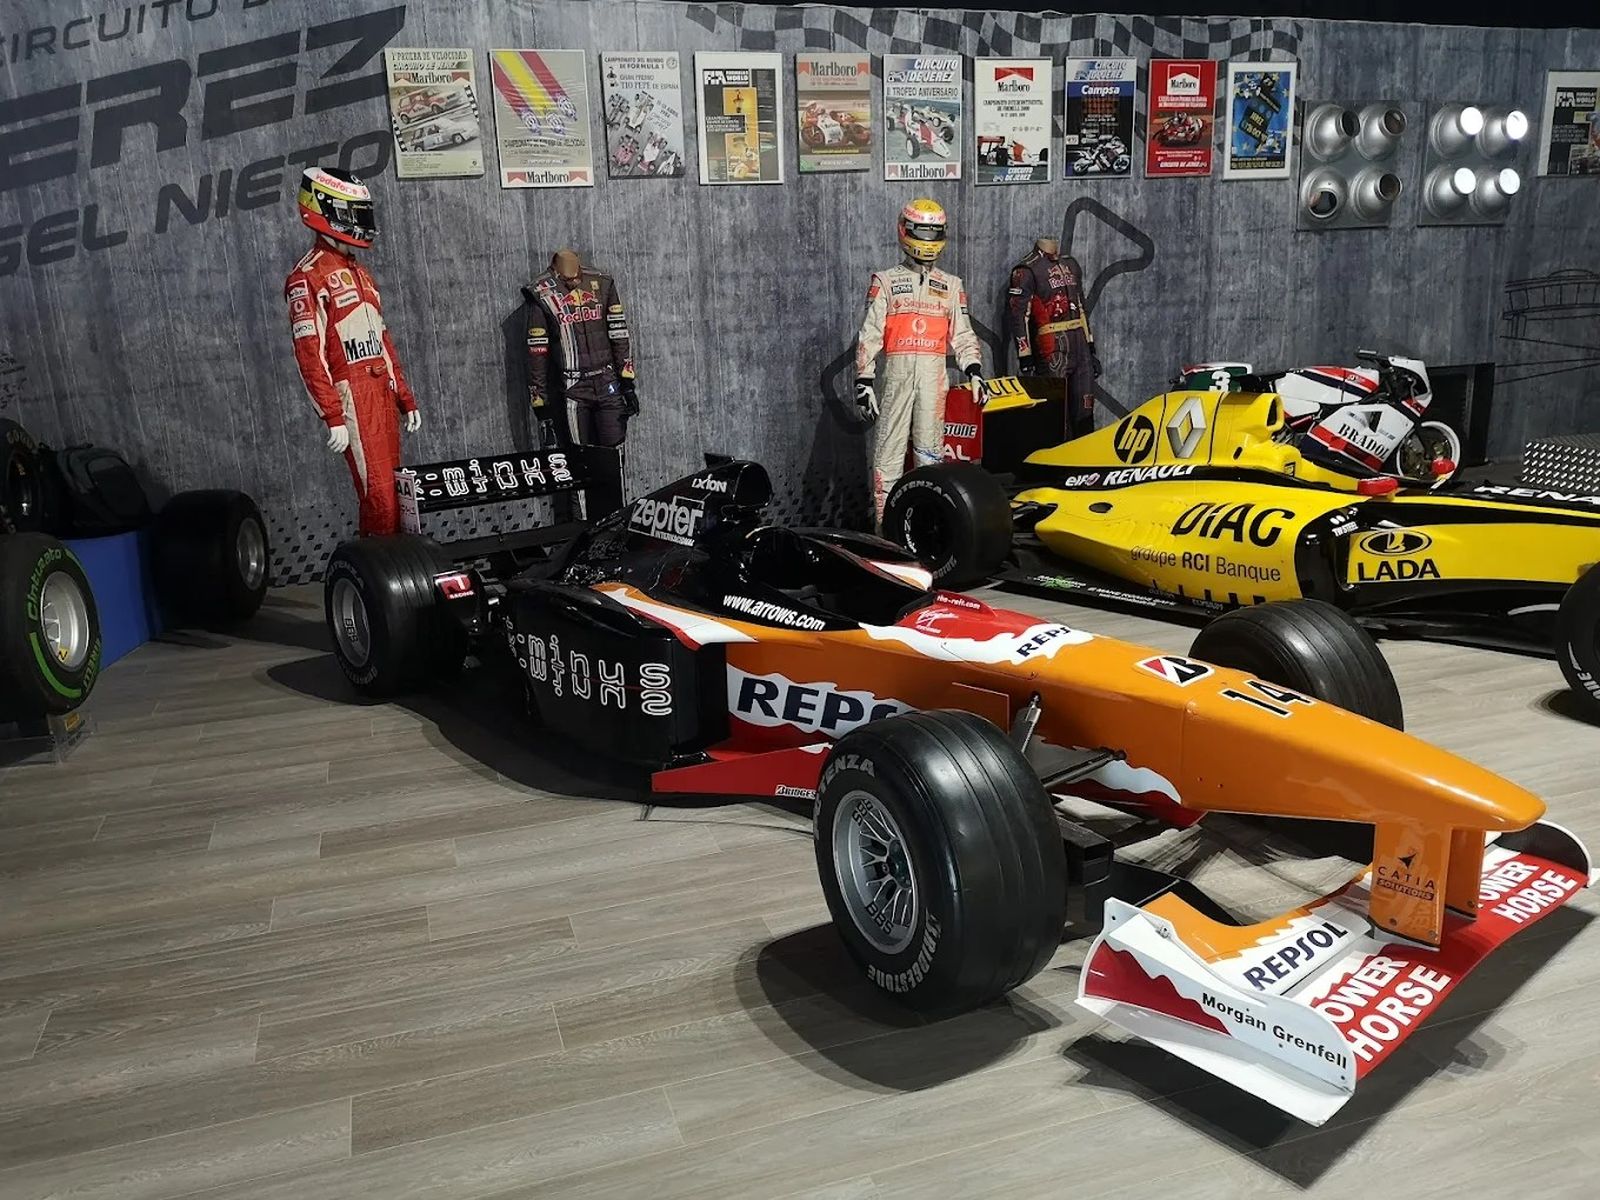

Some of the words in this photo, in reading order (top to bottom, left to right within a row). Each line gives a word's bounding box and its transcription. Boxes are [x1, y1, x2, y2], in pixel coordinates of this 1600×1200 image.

[0, 0, 218, 65] IRCUITO
[432, 51, 468, 60] VELOCIDAD
[914, 59, 959, 70] CIRCUITO
[411, 72, 452, 84] Marlboro
[811, 62, 857, 76] Marlboro
[922, 71, 955, 82] JEREZ
[893, 88, 917, 96] TROFEO
[919, 88, 958, 96] ANIVERSARIO
[998, 80, 1030, 92] Marlboro
[1081, 85, 1120, 96] Campsa
[1171, 79, 1196, 88] Marlboro
[154, 130, 393, 233] NIETO
[527, 171, 569, 183] Marlboro
[900, 164, 945, 178] Marlboro
[1050, 276, 1065, 289] Red
[557, 307, 582, 324] Red
[985, 377, 1022, 396] ULT
[1209, 371, 1231, 392] 3
[1117, 415, 1152, 464] hp
[1337, 422, 1391, 461] BRADOL
[1065, 475, 1088, 487] elf
[1103, 464, 1199, 487] RENAULT
[891, 480, 942, 508] POTENZA
[632, 497, 703, 537] zepter
[1130, 546, 1176, 567] groupe
[1182, 552, 1209, 572] RCI
[1216, 557, 1281, 582] Banque
[1357, 559, 1441, 582] LADA
[26, 548, 62, 621] Cinturato
[723, 594, 826, 631] www.arrows.com
[1222, 680, 1311, 716] 14
[1378, 866, 1435, 890] CATIA
[1378, 878, 1435, 901] SOLUTIONS
[1478, 860, 1541, 908] OWER
[1490, 869, 1578, 924] HORSE
[864, 901, 895, 935] BBS
[867, 910, 942, 992] BRIDGESTONE
[1243, 921, 1349, 991] REPSOL
[1346, 964, 1453, 1062] HORSE
[1202, 992, 1267, 1032] Morgan
[1272, 1025, 1347, 1070] Grenfell
